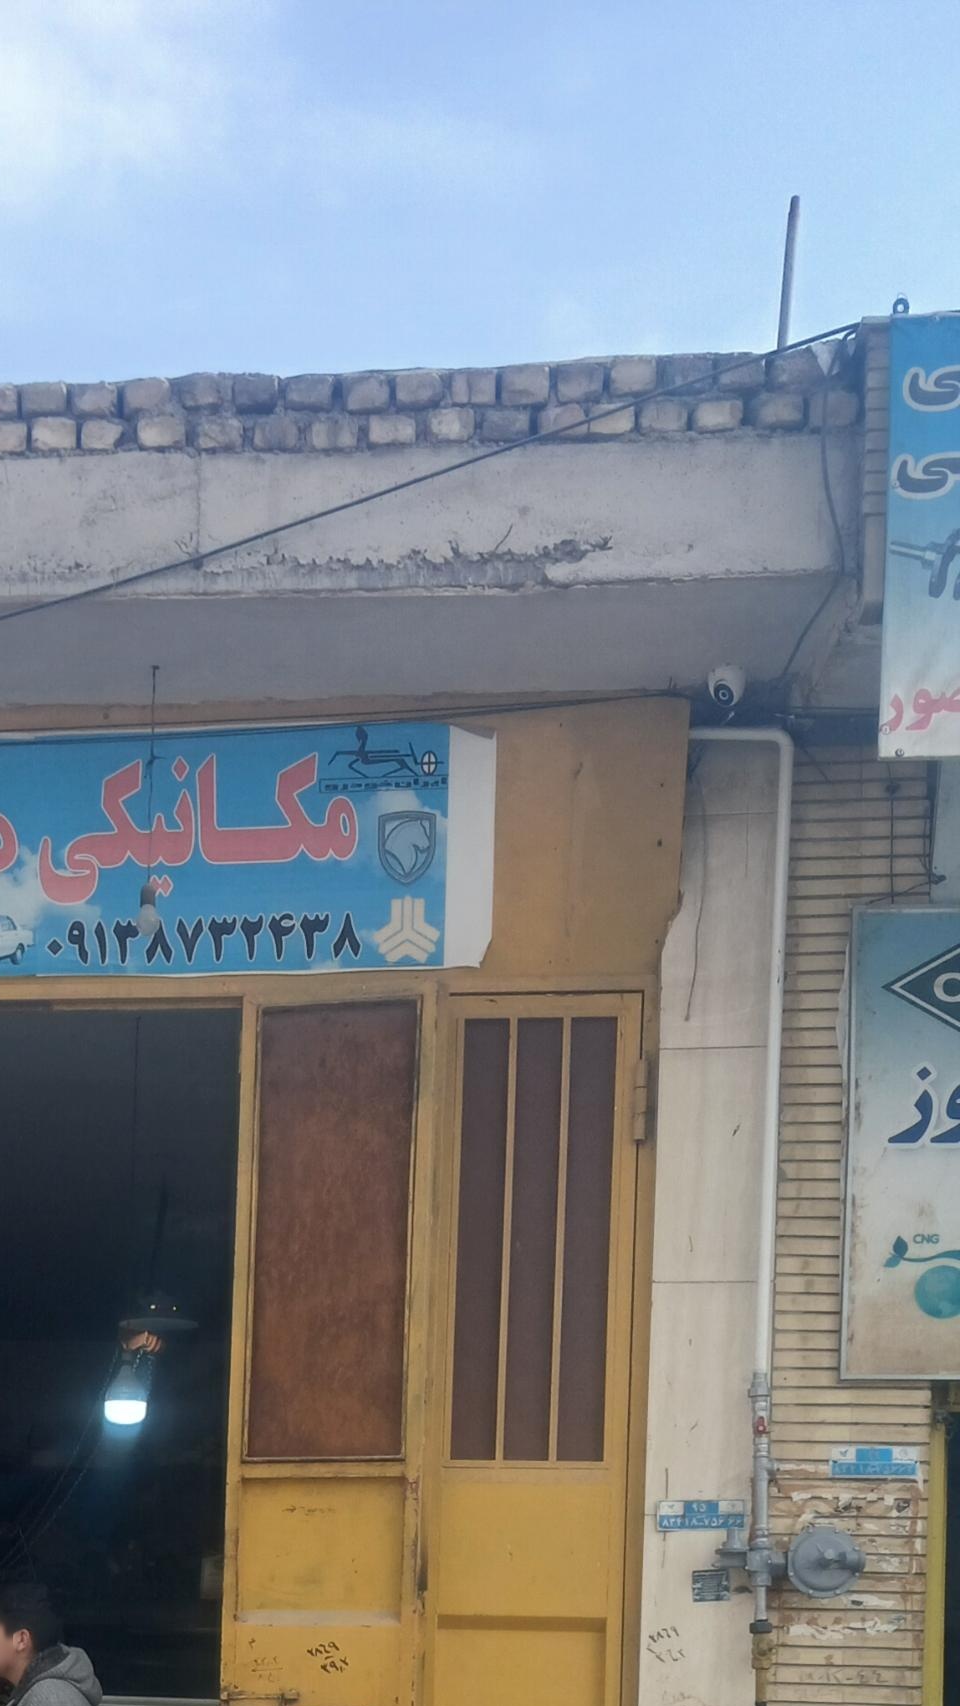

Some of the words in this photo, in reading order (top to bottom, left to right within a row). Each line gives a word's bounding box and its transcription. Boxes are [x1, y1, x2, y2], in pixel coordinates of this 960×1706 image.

[40, 750, 359, 906] مکانیکی
[46, 912, 362, 966] ۰۹۱۳۸۷۳۲۴۳۸
[912, 1233, 940, 1245] CNG
